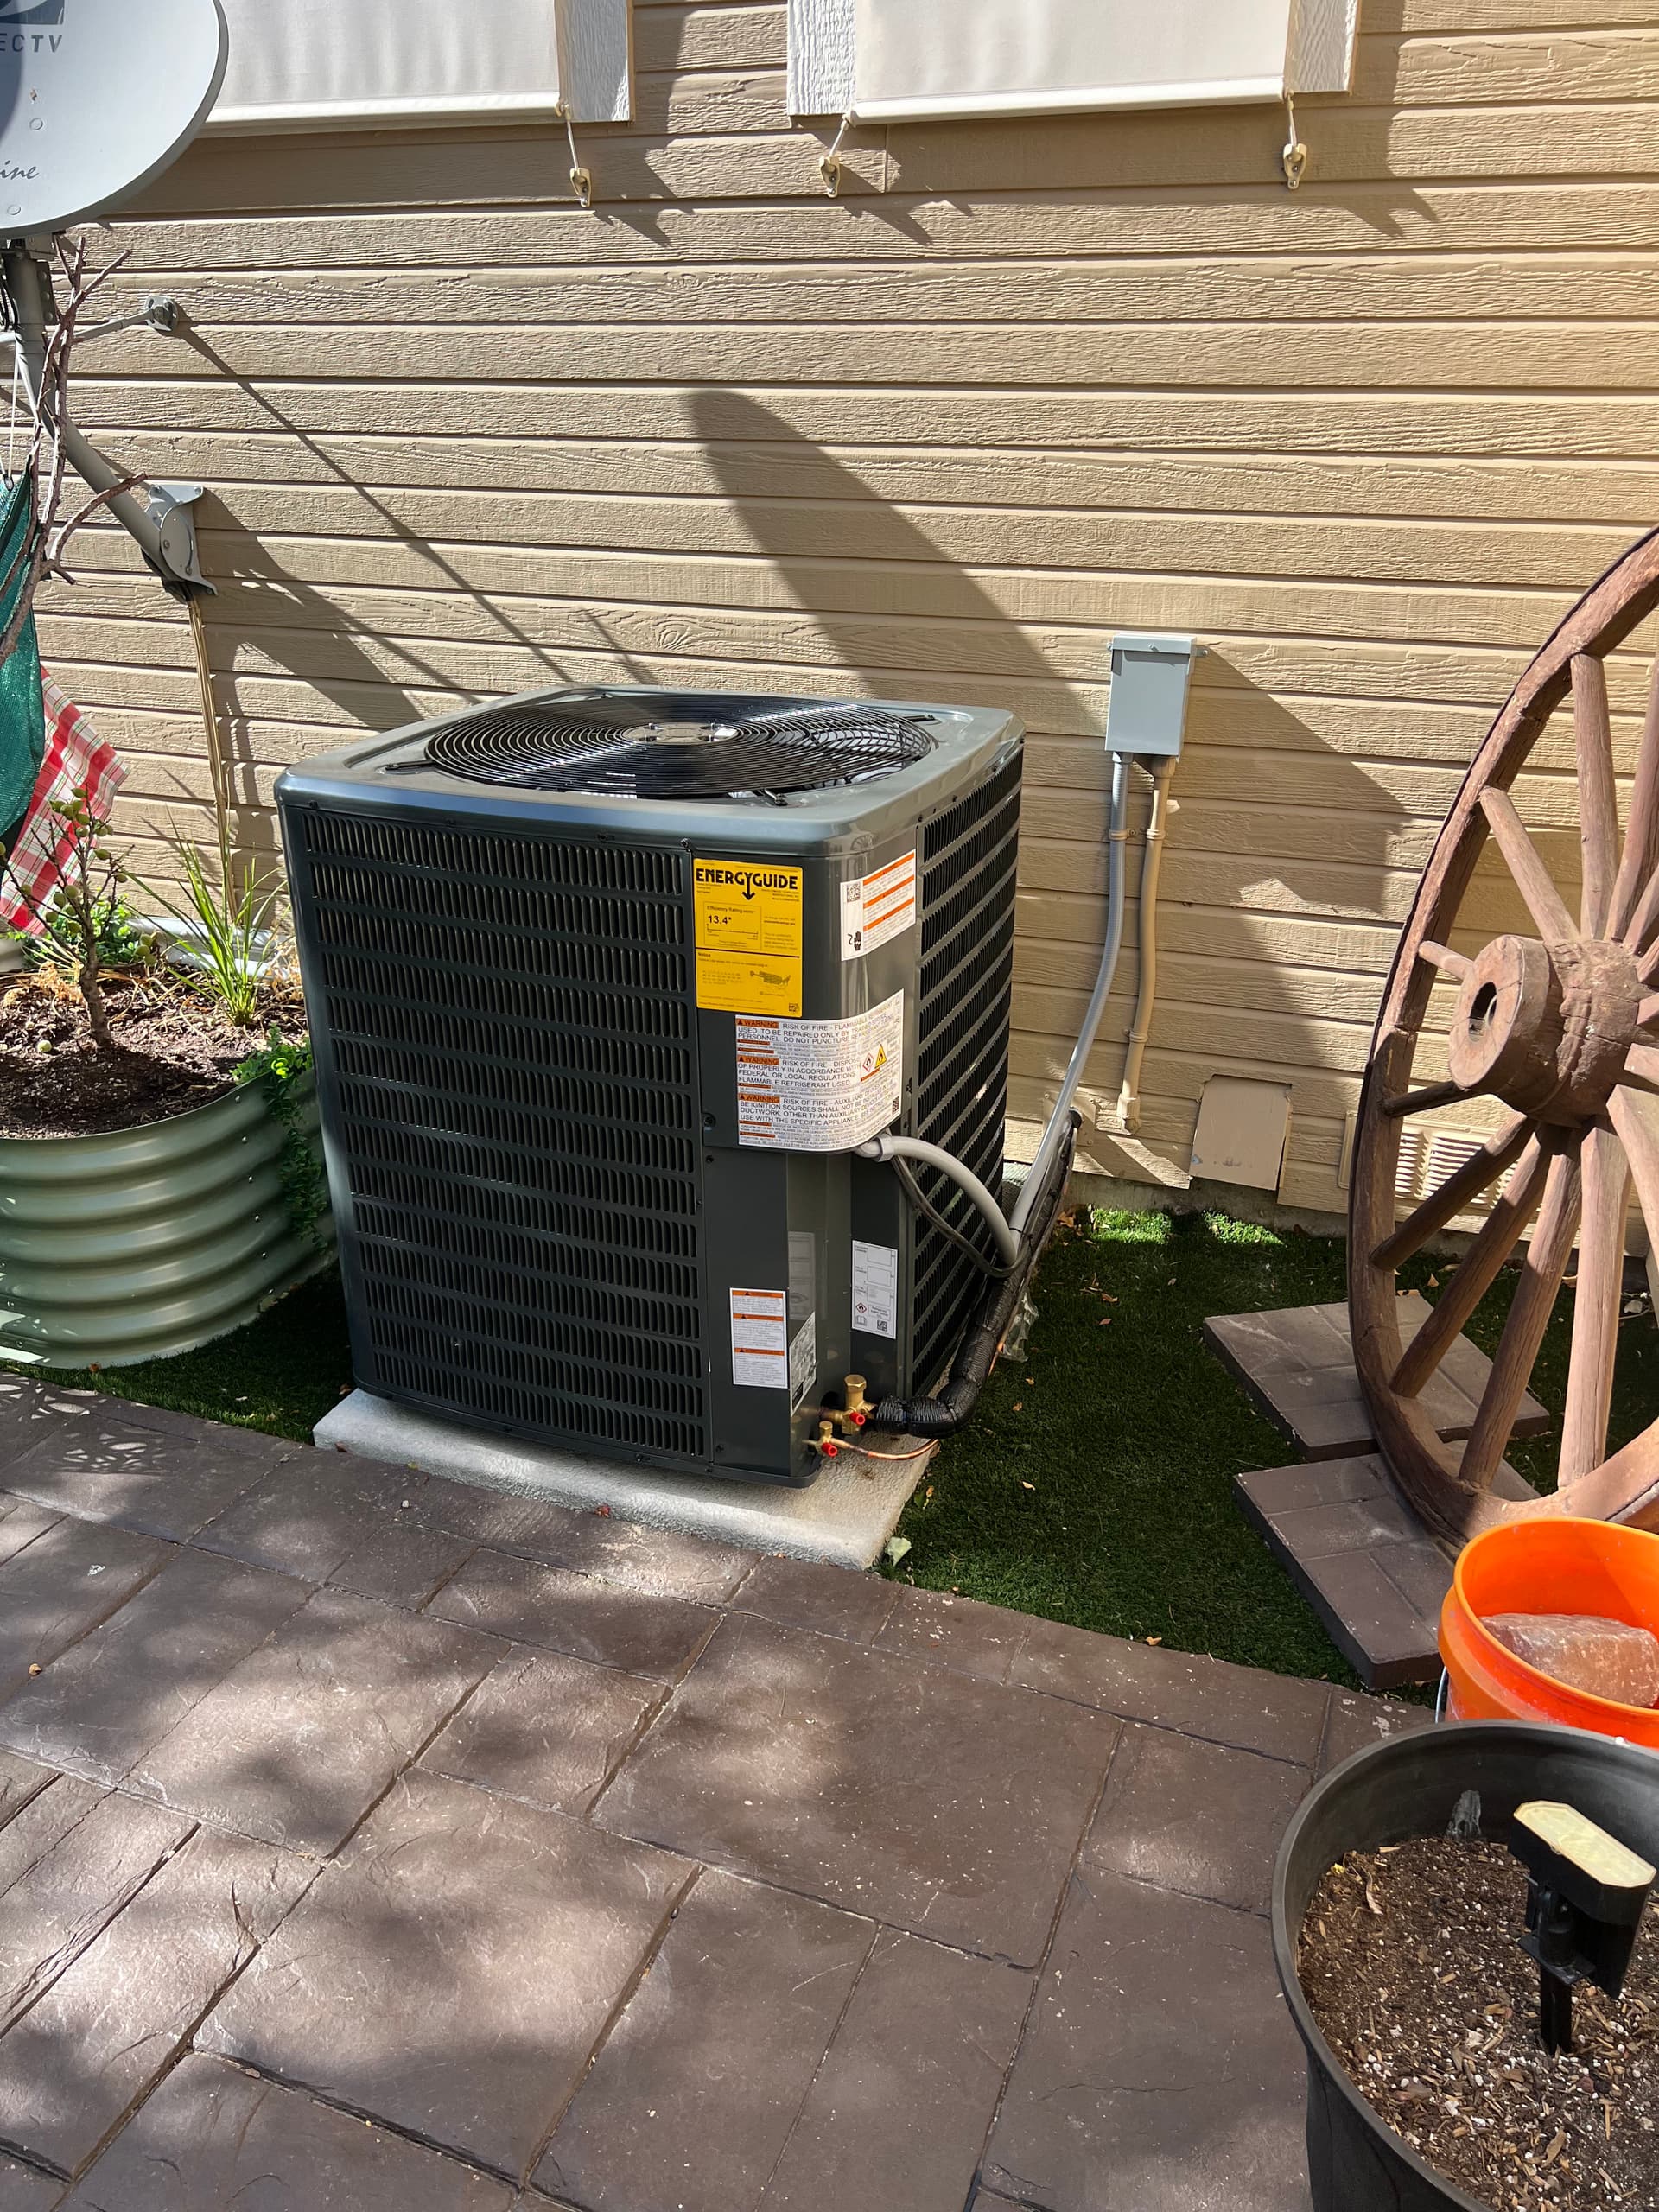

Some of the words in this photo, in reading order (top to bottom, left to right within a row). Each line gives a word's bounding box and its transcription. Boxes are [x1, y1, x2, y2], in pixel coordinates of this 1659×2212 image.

[744, 1020, 778, 1029] WARNING
[745, 1057, 778, 1065] WARNING
[748, 1064, 785, 1072] PROPERLY
[738, 1076, 779, 1085] FLAMMABLE
[781, 1080, 830, 1089] REFRIGERANT
[746, 1095, 779, 1103] WARNING
